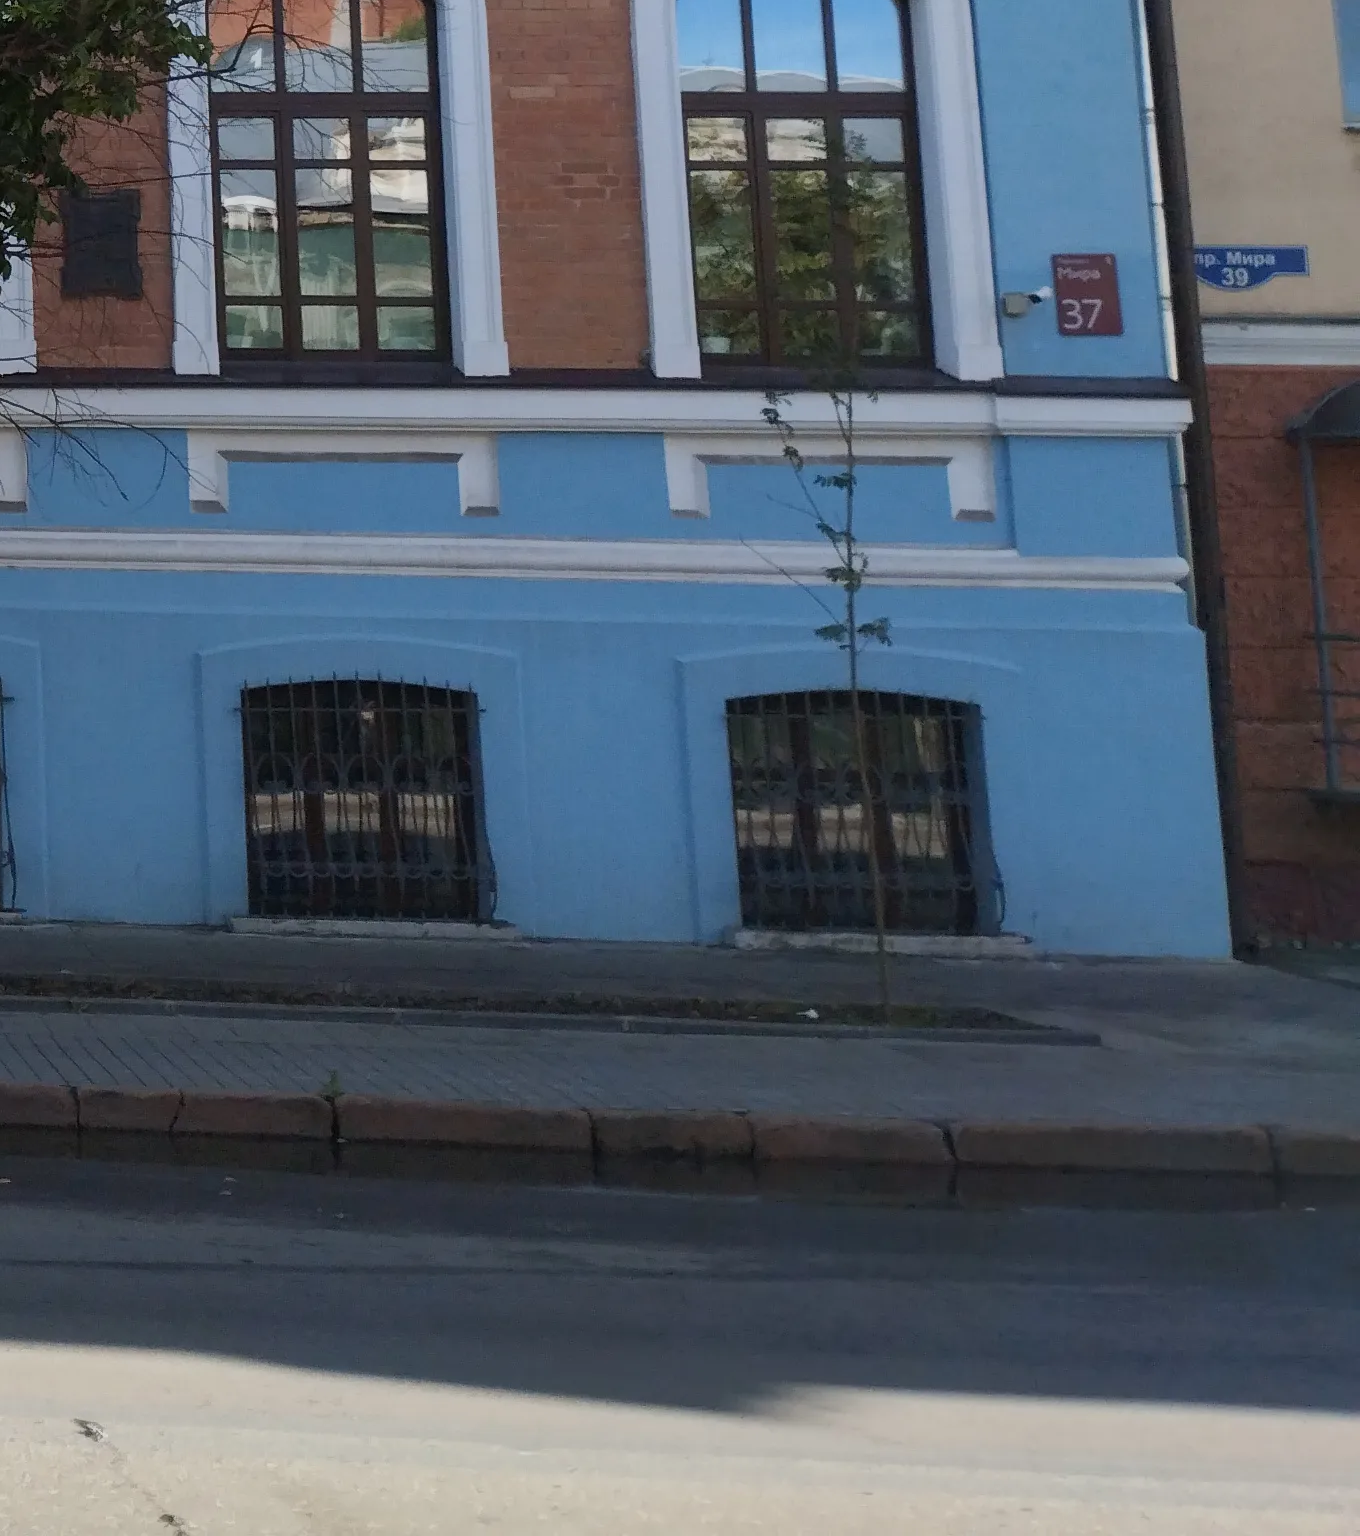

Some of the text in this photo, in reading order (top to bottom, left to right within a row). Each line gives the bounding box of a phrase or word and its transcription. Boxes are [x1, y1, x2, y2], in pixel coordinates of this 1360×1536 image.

[1226, 251, 1276, 268] Мира
[1057, 266, 1102, 282] Мира
[1221, 267, 1249, 286] 39
[1061, 298, 1103, 330] 37
